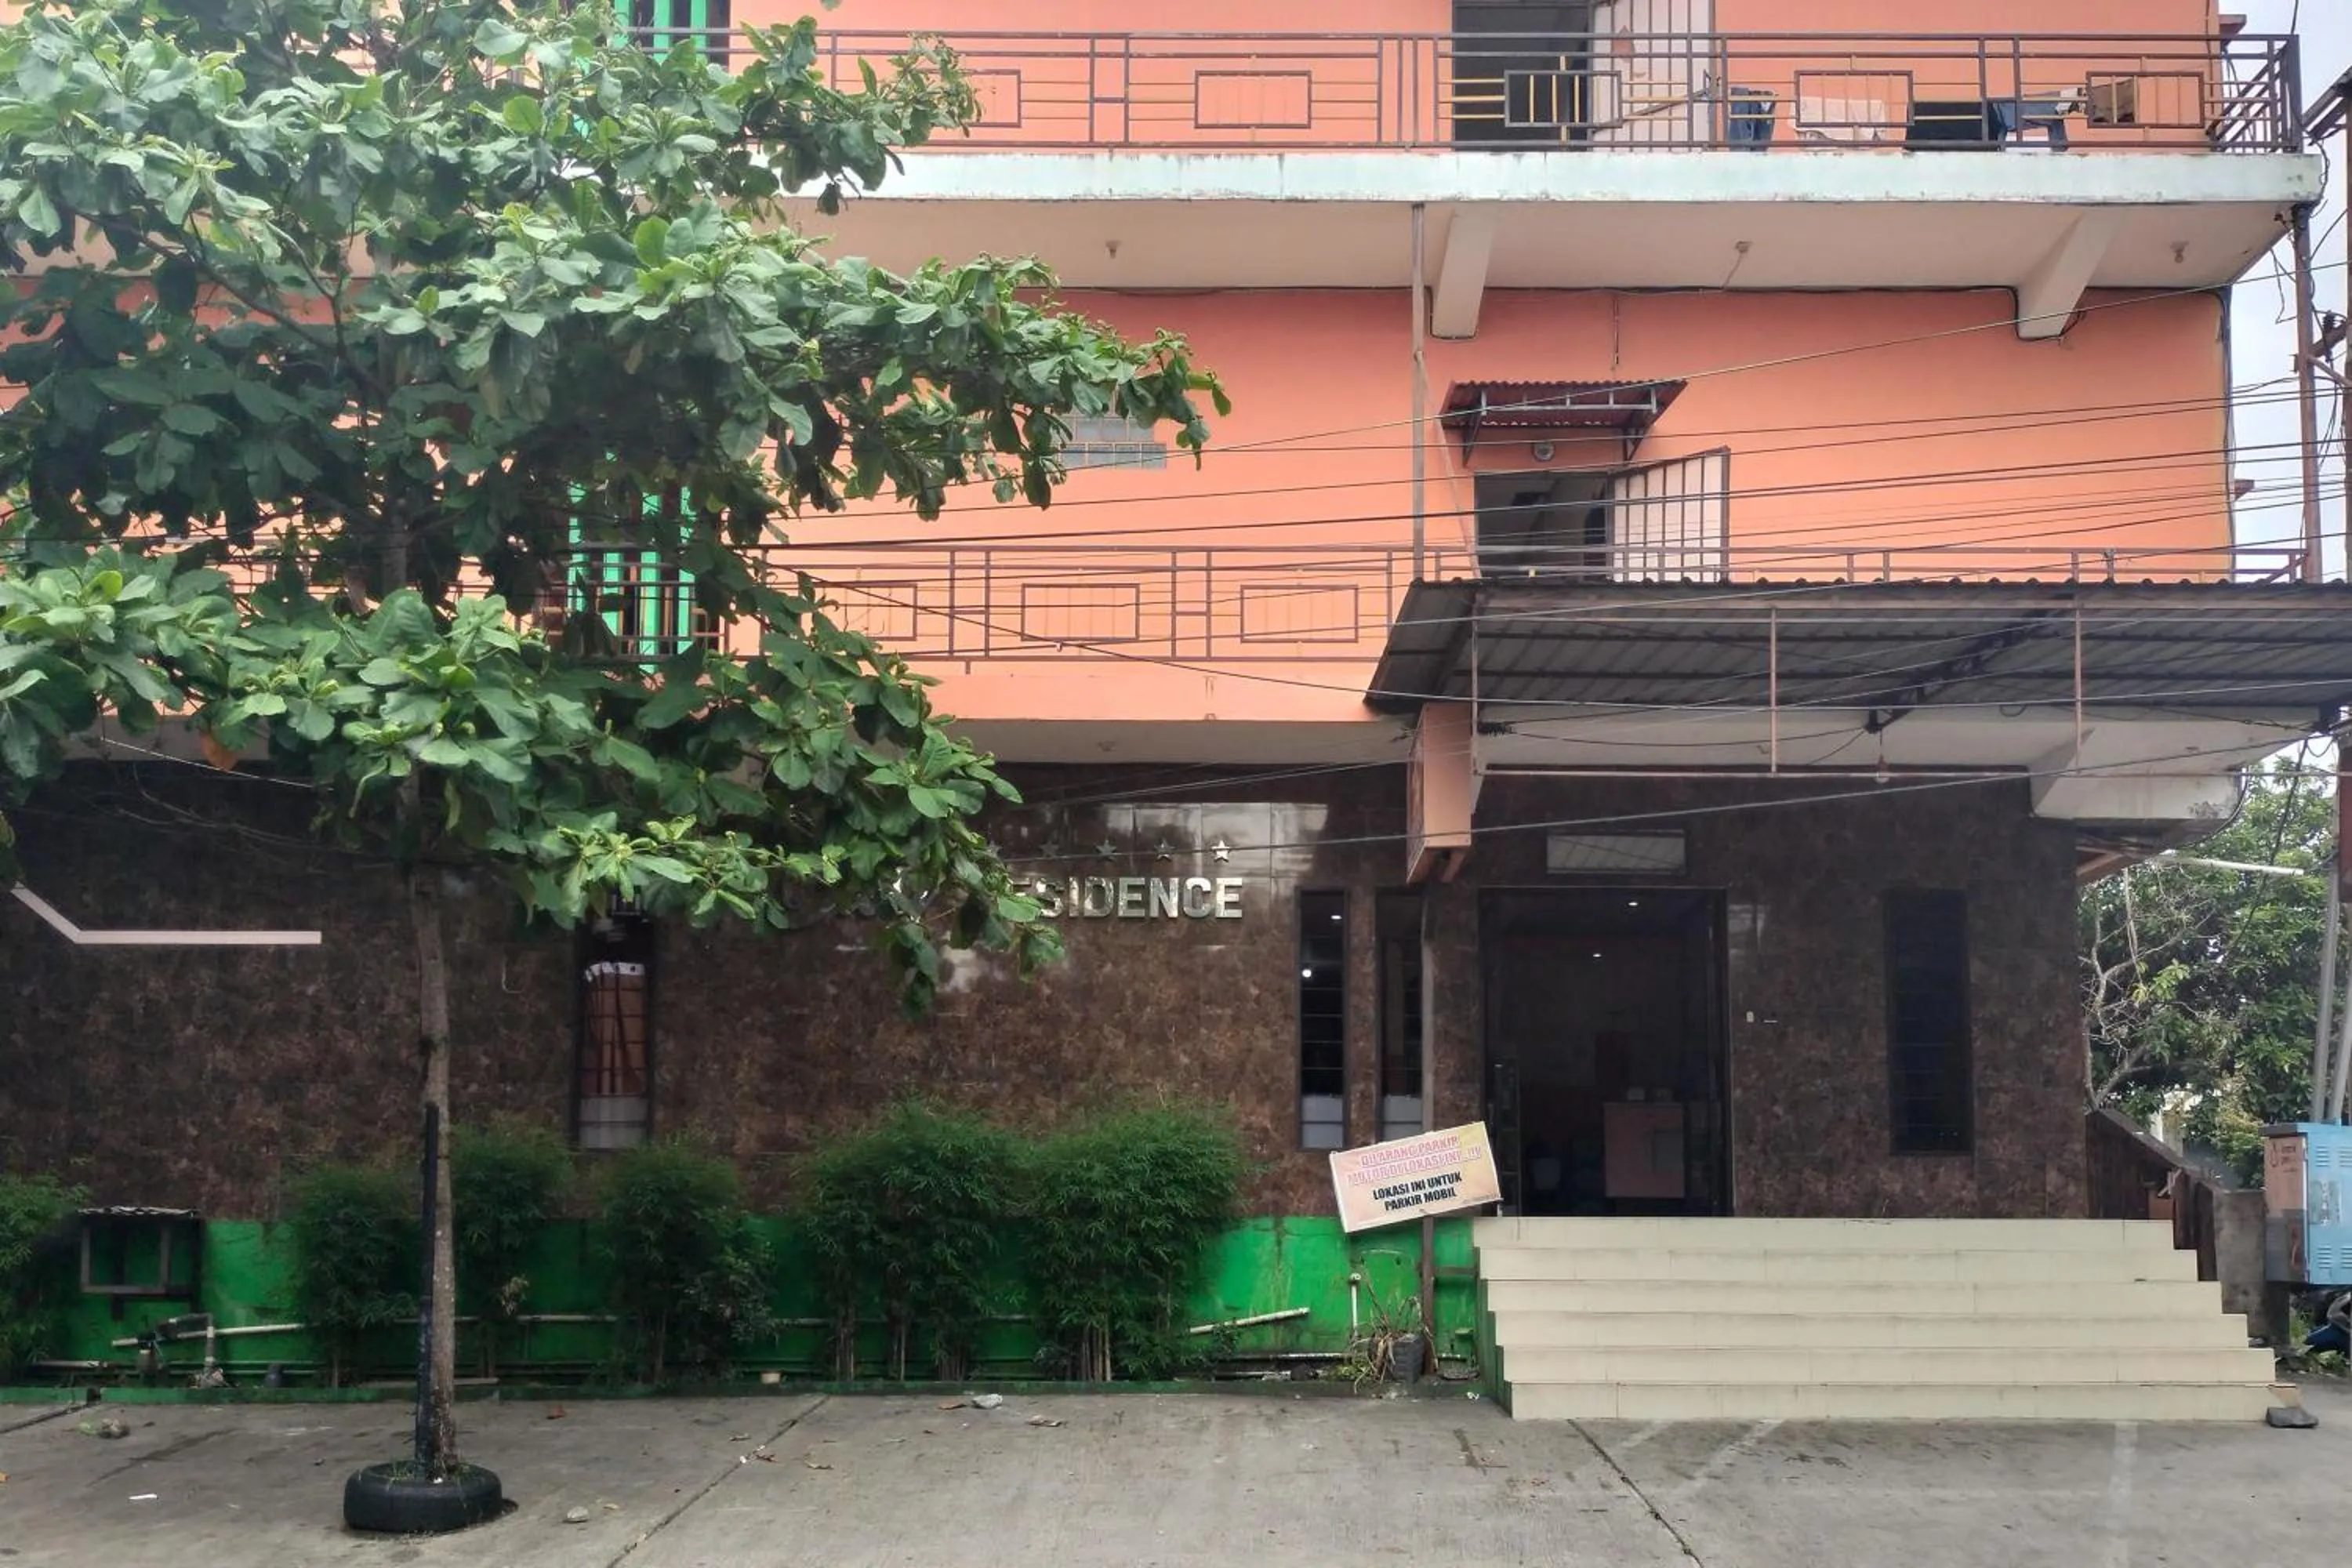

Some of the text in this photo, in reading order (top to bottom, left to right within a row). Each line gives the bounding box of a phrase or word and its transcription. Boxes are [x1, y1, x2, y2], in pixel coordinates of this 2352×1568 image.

[1418, 1136, 1461, 1156] PARKIR
[1373, 1171, 1462, 1200] LOKASI INI UNTUK
[1385, 1194, 1422, 1210] PARKIR
[1424, 1187, 1457, 1203] MOBIL
